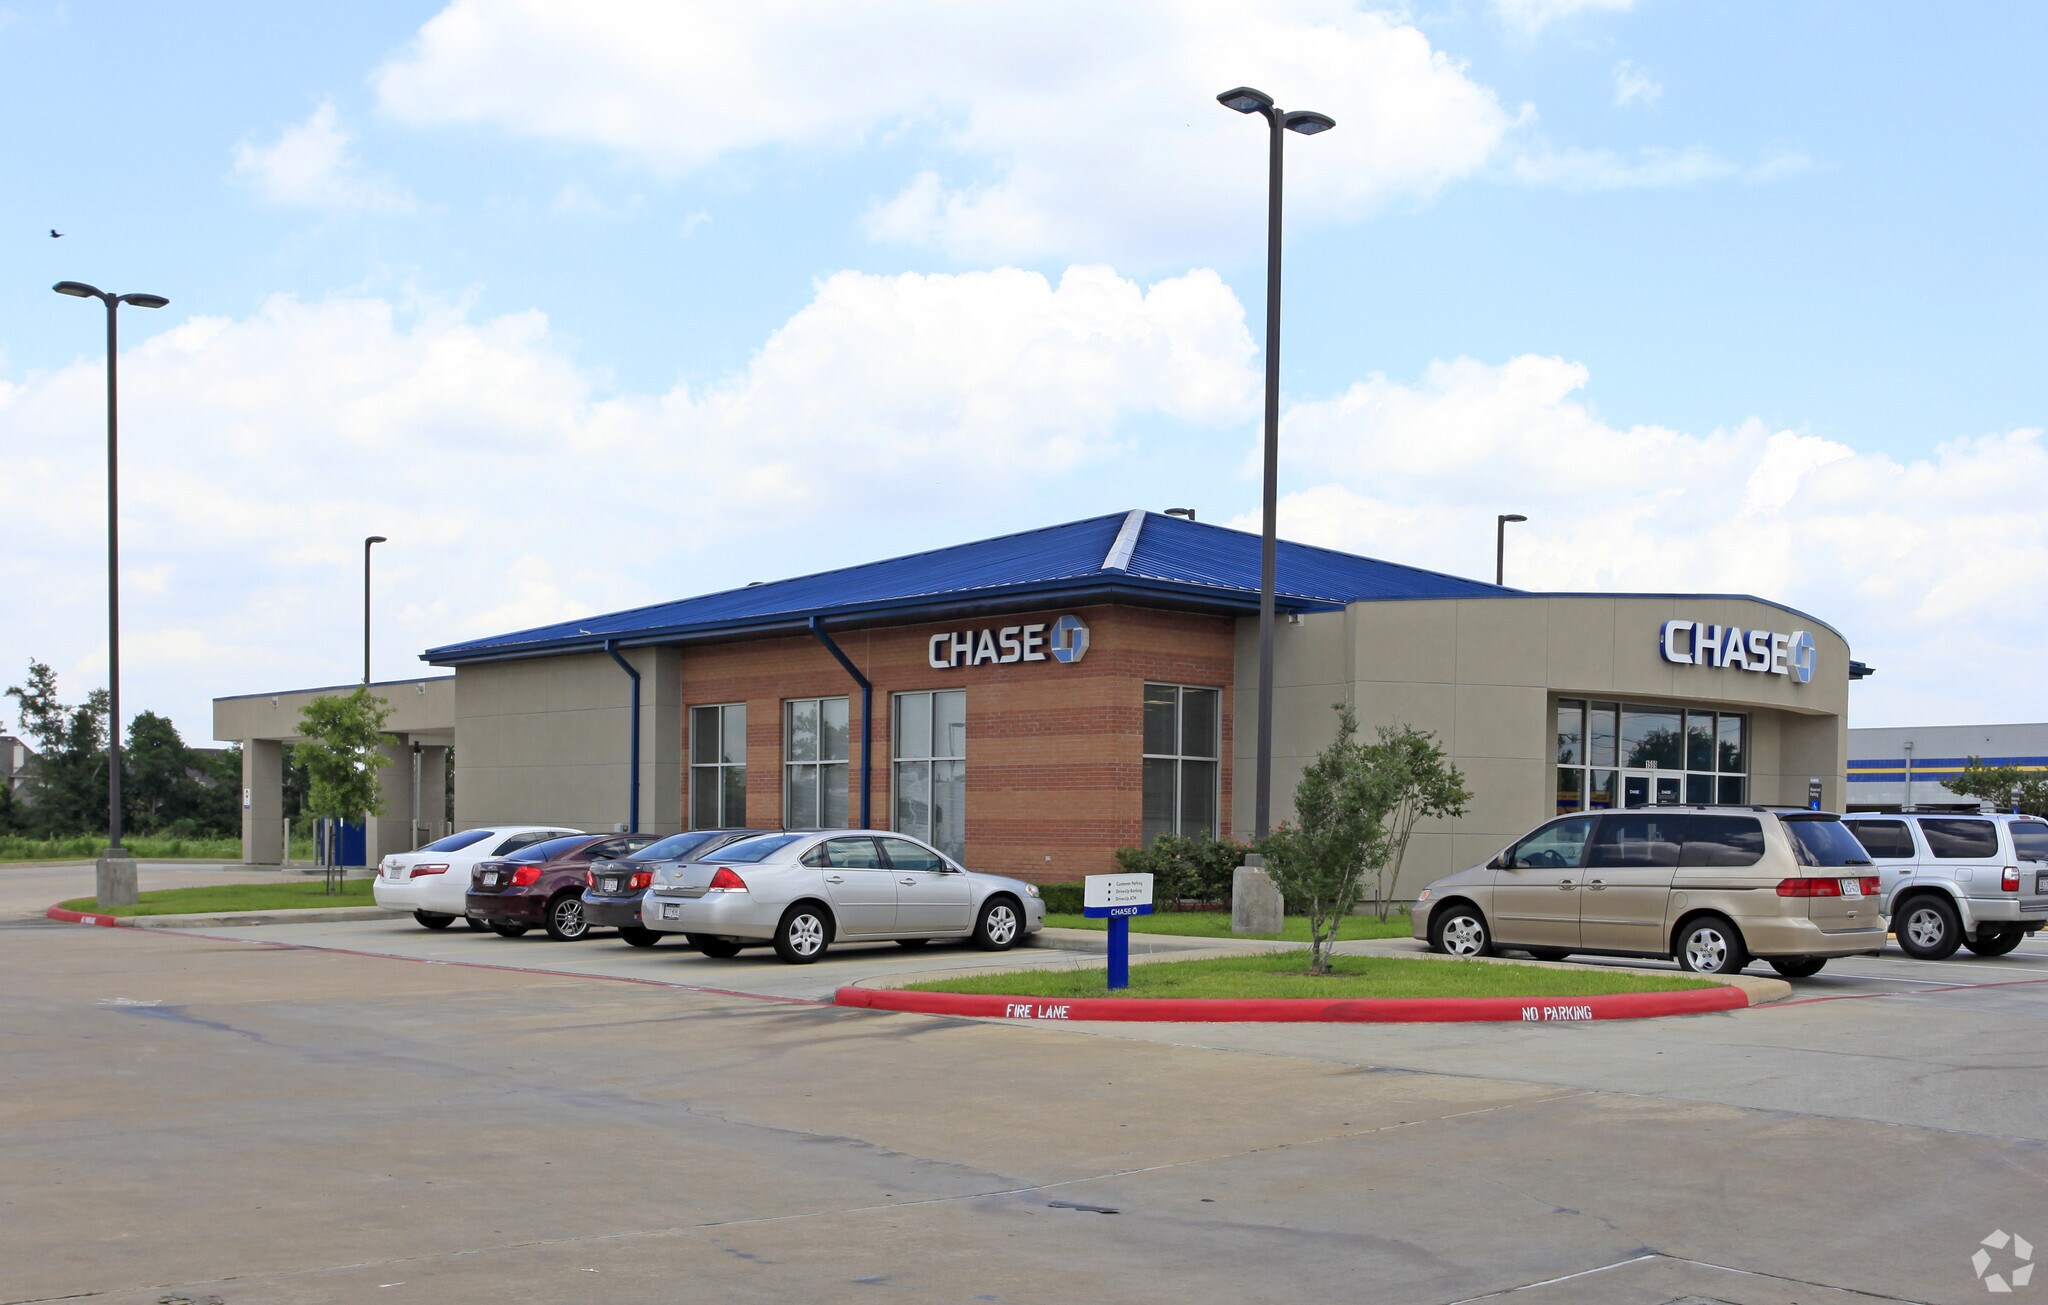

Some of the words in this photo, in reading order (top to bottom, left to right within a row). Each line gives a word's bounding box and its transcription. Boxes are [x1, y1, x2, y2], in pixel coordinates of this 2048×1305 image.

[928, 623, 1046, 669] CHASE
[1660, 619, 1789, 675] CHASE
[1006, 1003, 1033, 1019] FIRE
[1038, 1004, 1070, 1019] LANE
[1521, 1006, 1539, 1021] NO
[1543, 1005, 1592, 1021] PARKING
